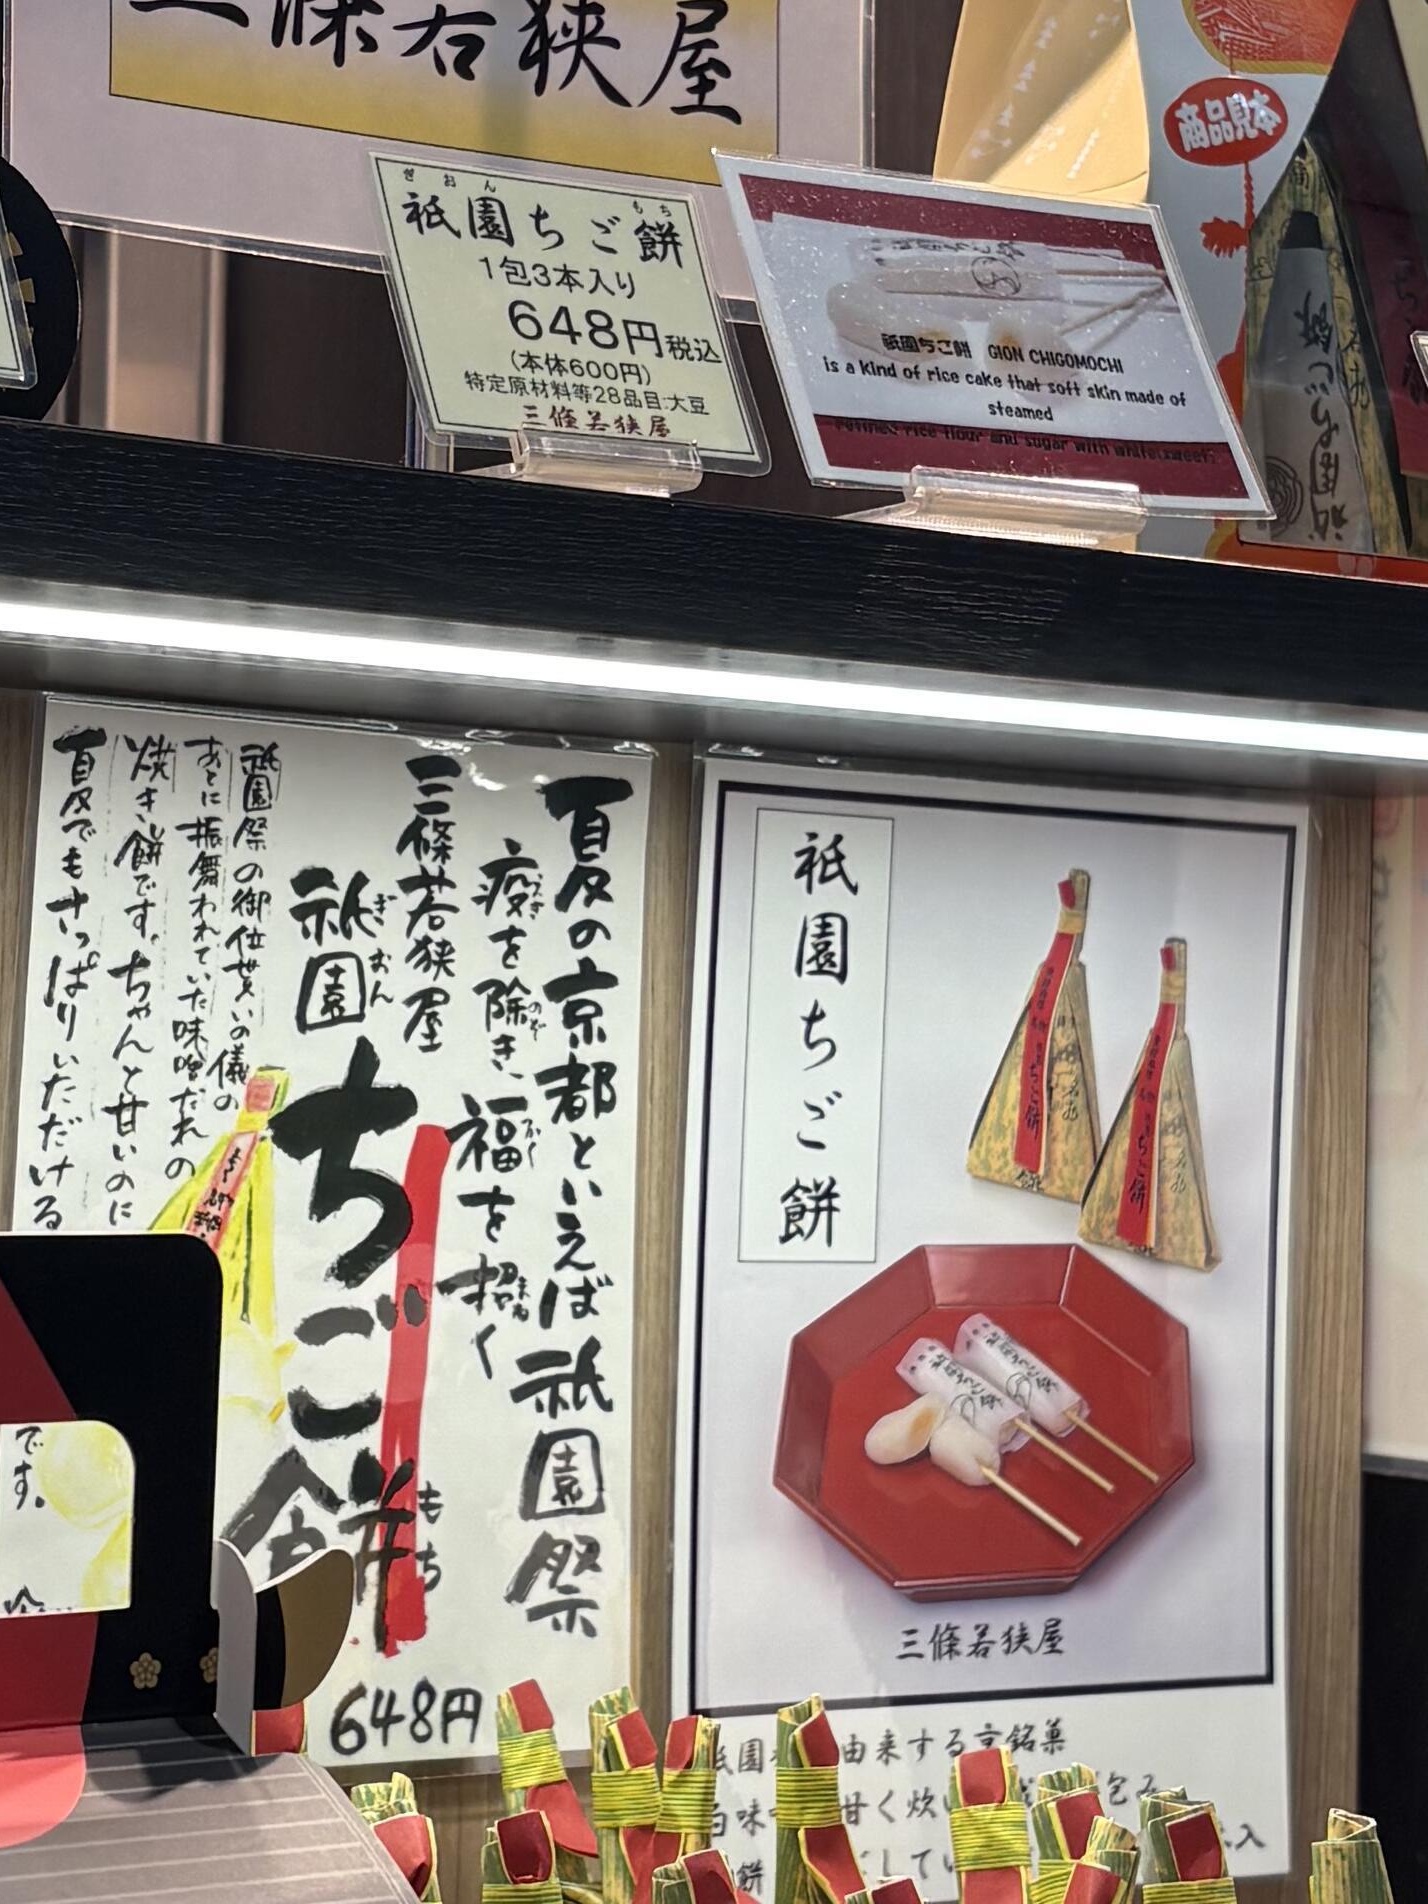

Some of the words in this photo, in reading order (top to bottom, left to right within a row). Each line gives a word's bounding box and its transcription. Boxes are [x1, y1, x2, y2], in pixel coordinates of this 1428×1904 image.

[1176, 91, 1285, 153] 商品見本
[402, 191, 684, 269] 祇園ちご餅
[478, 256, 637, 299] 1包3本入り
[510, 350, 651, 386] (本体600円)
[824, 357, 839, 373] is
[843, 363, 856, 375] a
[859, 359, 897, 379] kind
[903, 363, 921, 382] of
[927, 367, 960, 384] rice
[965, 370, 1003, 389] cake
[1007, 373, 1042, 392] that
[1048, 377, 1081, 399] soft
[1088, 383, 1121, 401] skin
[1125, 388, 1165, 406] made
[1170, 391, 1187, 408] of
[987, 342, 1024, 364] GION
[1029, 349, 1123, 375] CHIGOMOCHI
[988, 399, 1054, 422] steamed
[395, 755, 463, 1053] 三條若狭屋
[776, 829, 861, 1252] 祇園ちご餅
[504, 777, 634, 1639] 夏の京都といえば祇園祭
[896, 1615, 1067, 1665] 三條若狭屋
[329, 1678, 483, 1756] 648円
